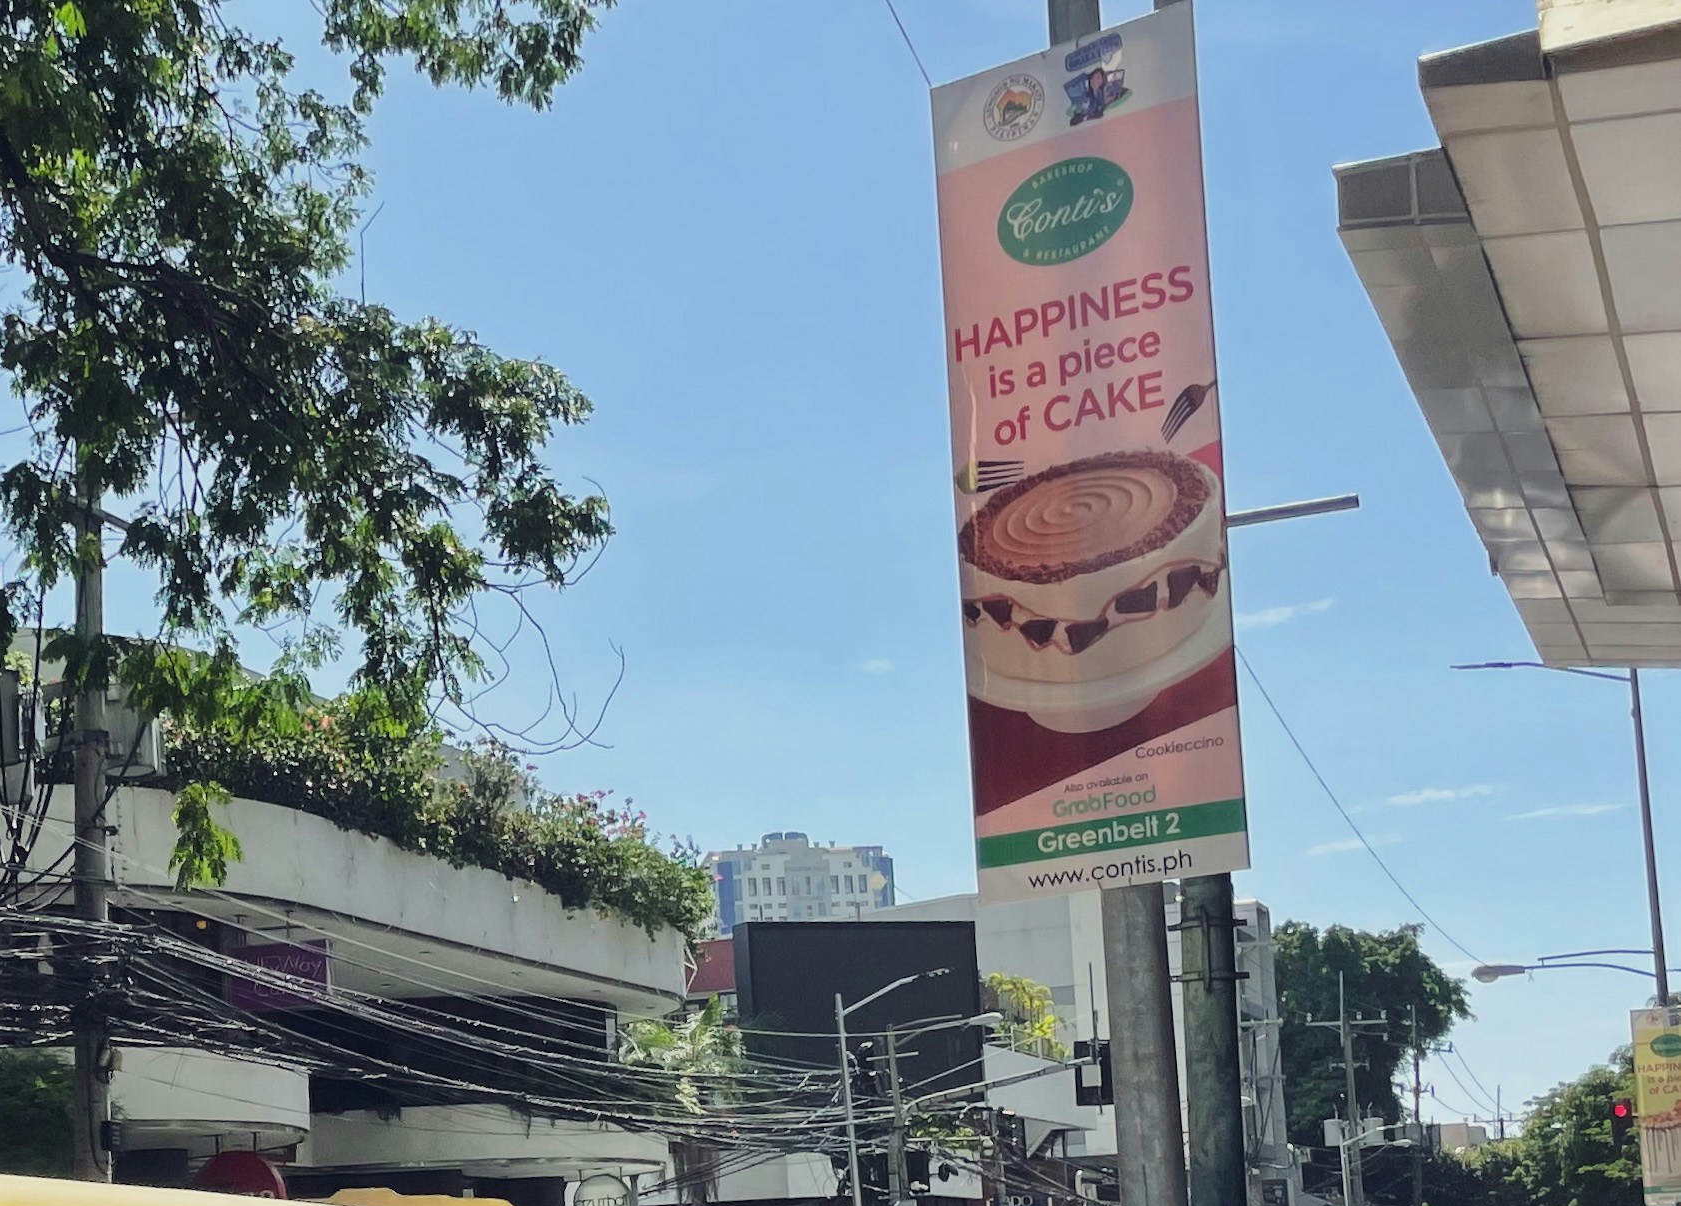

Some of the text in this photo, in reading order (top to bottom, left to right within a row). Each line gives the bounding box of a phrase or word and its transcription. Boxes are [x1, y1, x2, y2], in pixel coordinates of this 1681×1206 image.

[1036, 225, 1111, 260] RESTAURANT
[954, 265, 1194, 362] HAPPINESS
[989, 330, 1161, 398] is a piece
[994, 371, 1165, 446] of CAKE
[1135, 734, 1224, 760] Cookieccino
[1052, 784, 1157, 819] GrabFood
[1064, 772, 1148, 794] Also available on
[1037, 812, 1181, 853] Greenbelt 2
[1028, 849, 1193, 889] www.contis.ph
[1663, 1084, 1681, 1094] CA
